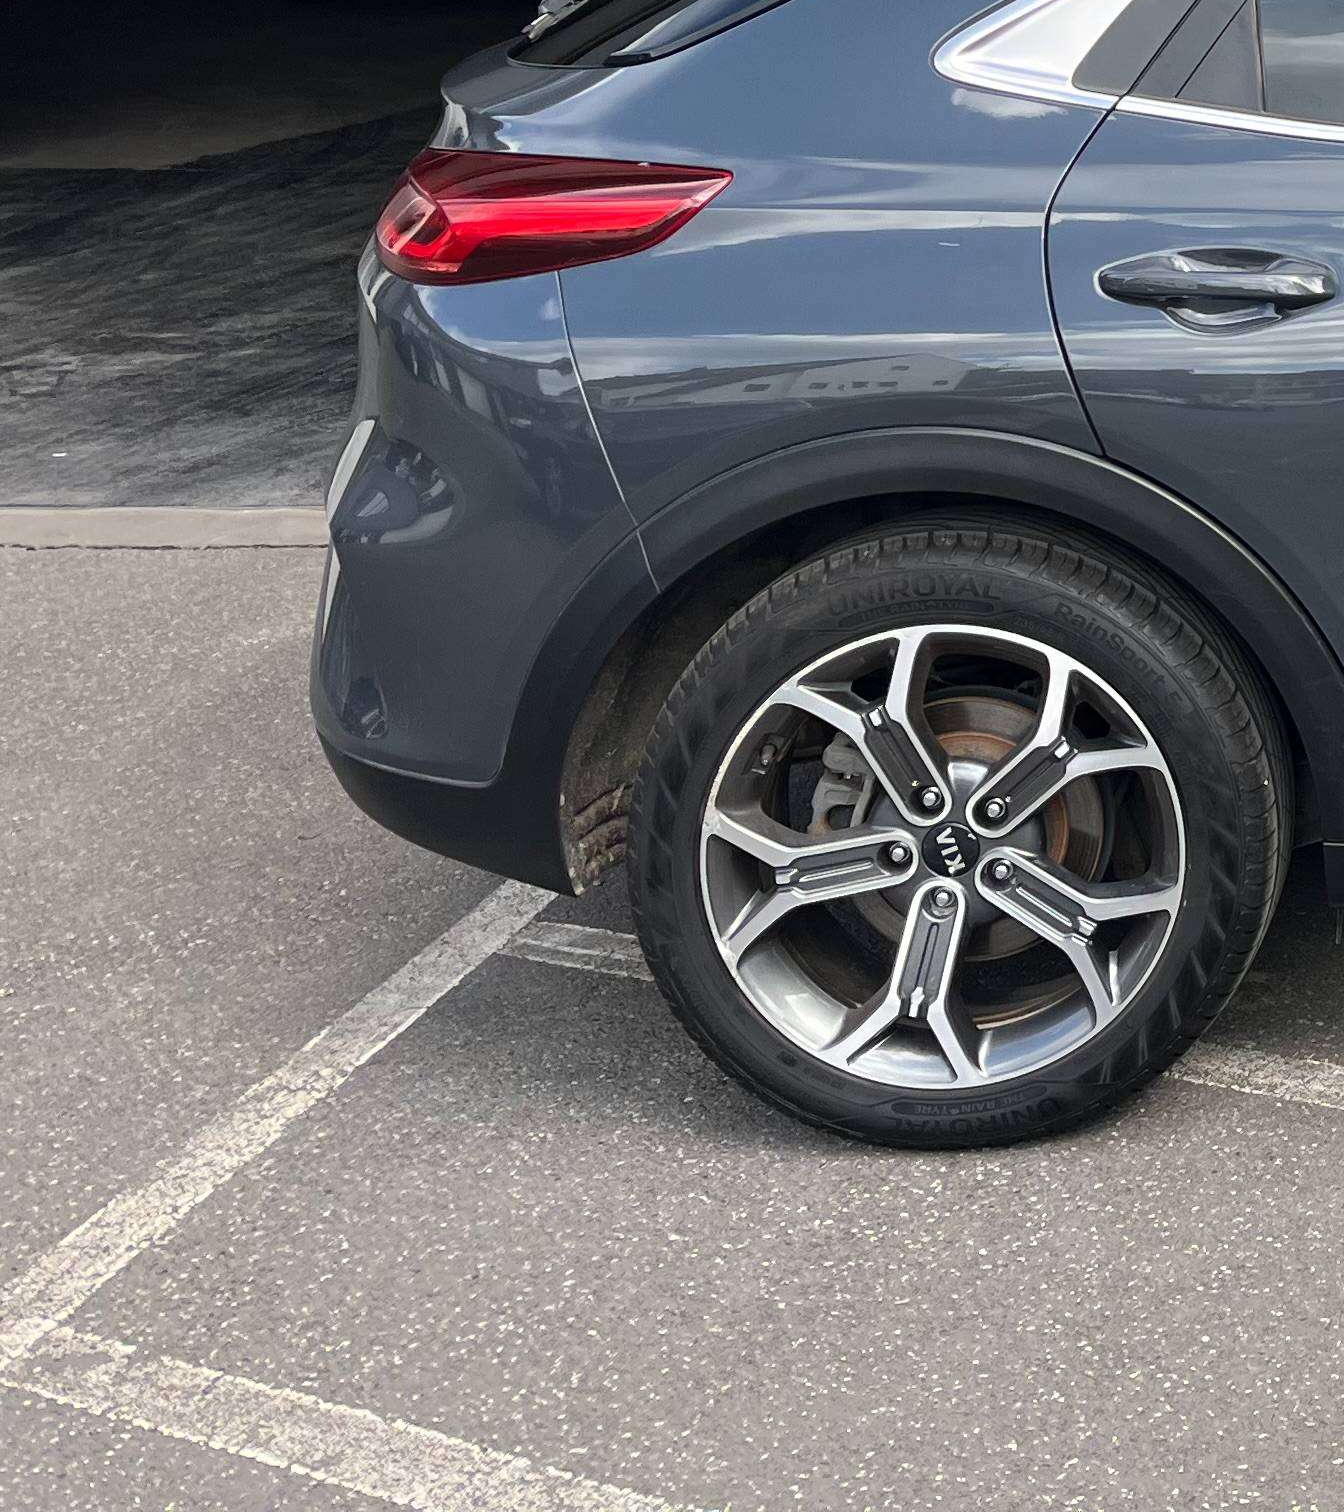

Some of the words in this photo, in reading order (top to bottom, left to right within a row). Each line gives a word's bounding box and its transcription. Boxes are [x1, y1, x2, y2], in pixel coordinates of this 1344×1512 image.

[827, 574, 1001, 617] UNIROYAL
[1054, 602, 1166, 687] RainSport
[935, 826, 966, 875] KIA
